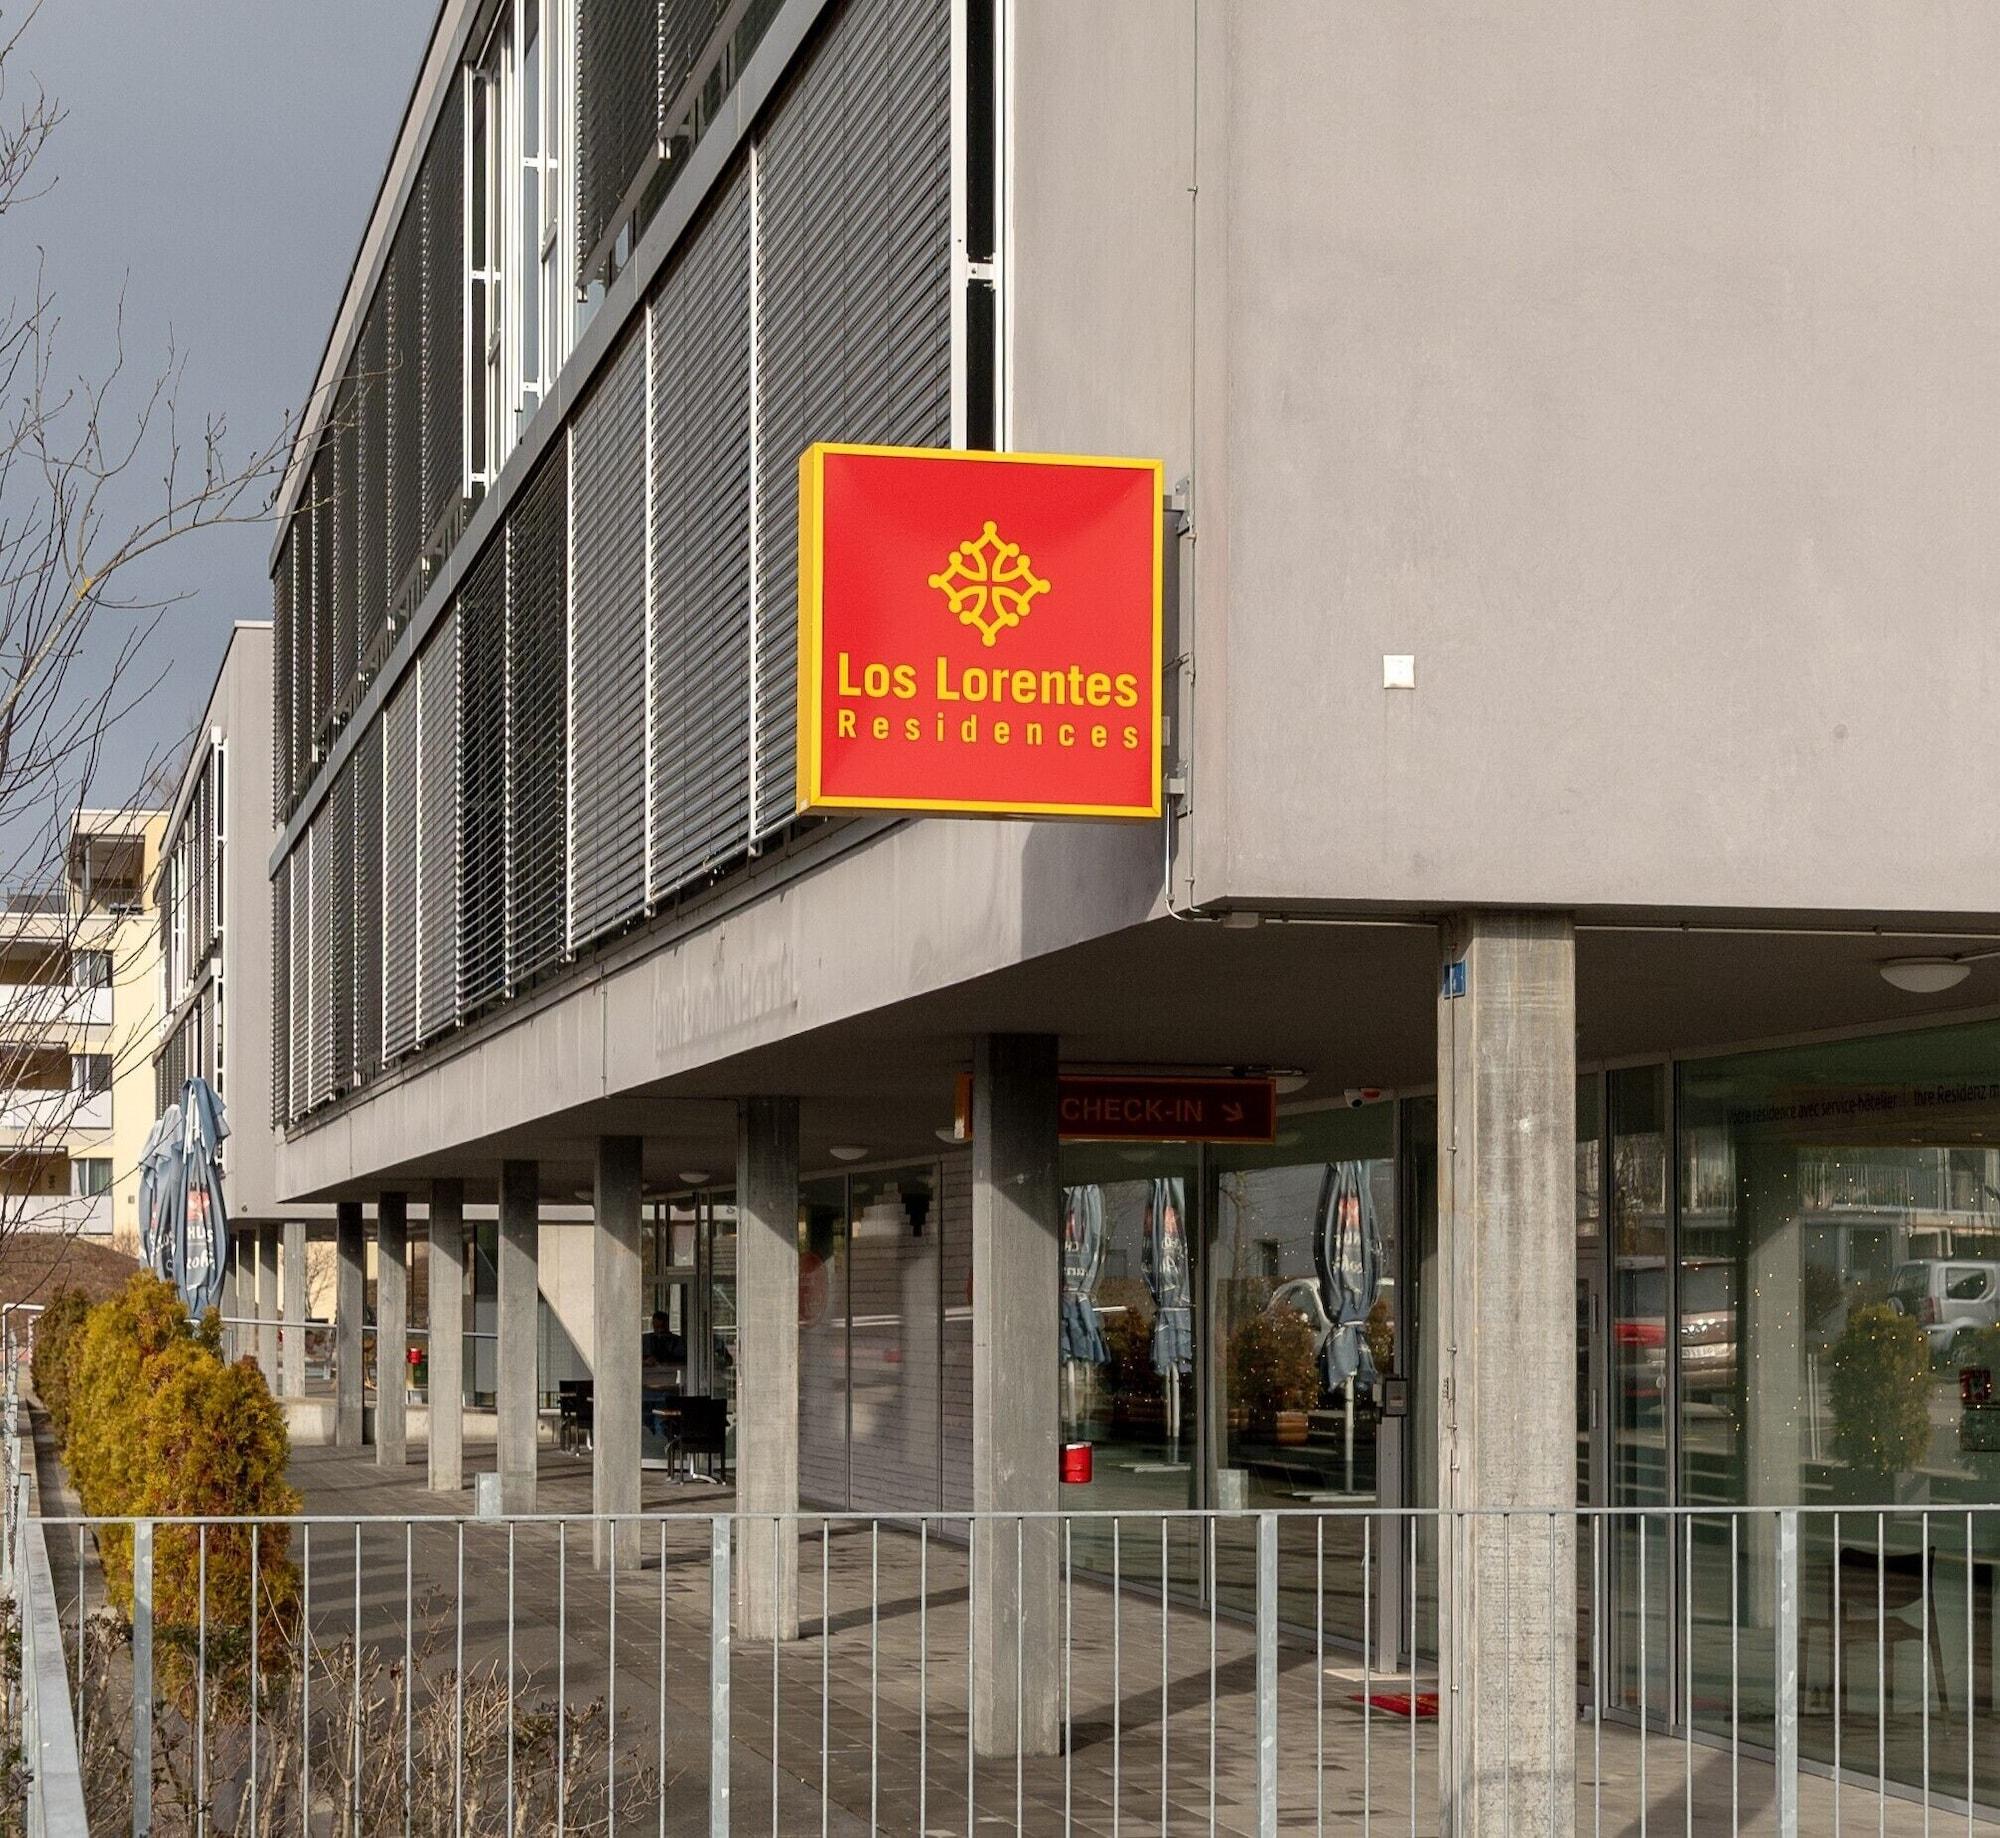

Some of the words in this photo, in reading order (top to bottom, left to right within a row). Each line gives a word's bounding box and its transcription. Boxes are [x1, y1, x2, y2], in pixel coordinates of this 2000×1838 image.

[838, 652, 917, 699] Los
[936, 656, 1139, 708] Lorentes
[838, 709, 1139, 749] Residences
[1061, 1097, 1202, 1123] CHECK-IN
[1936, 1082, 1986, 1105] Residenz
